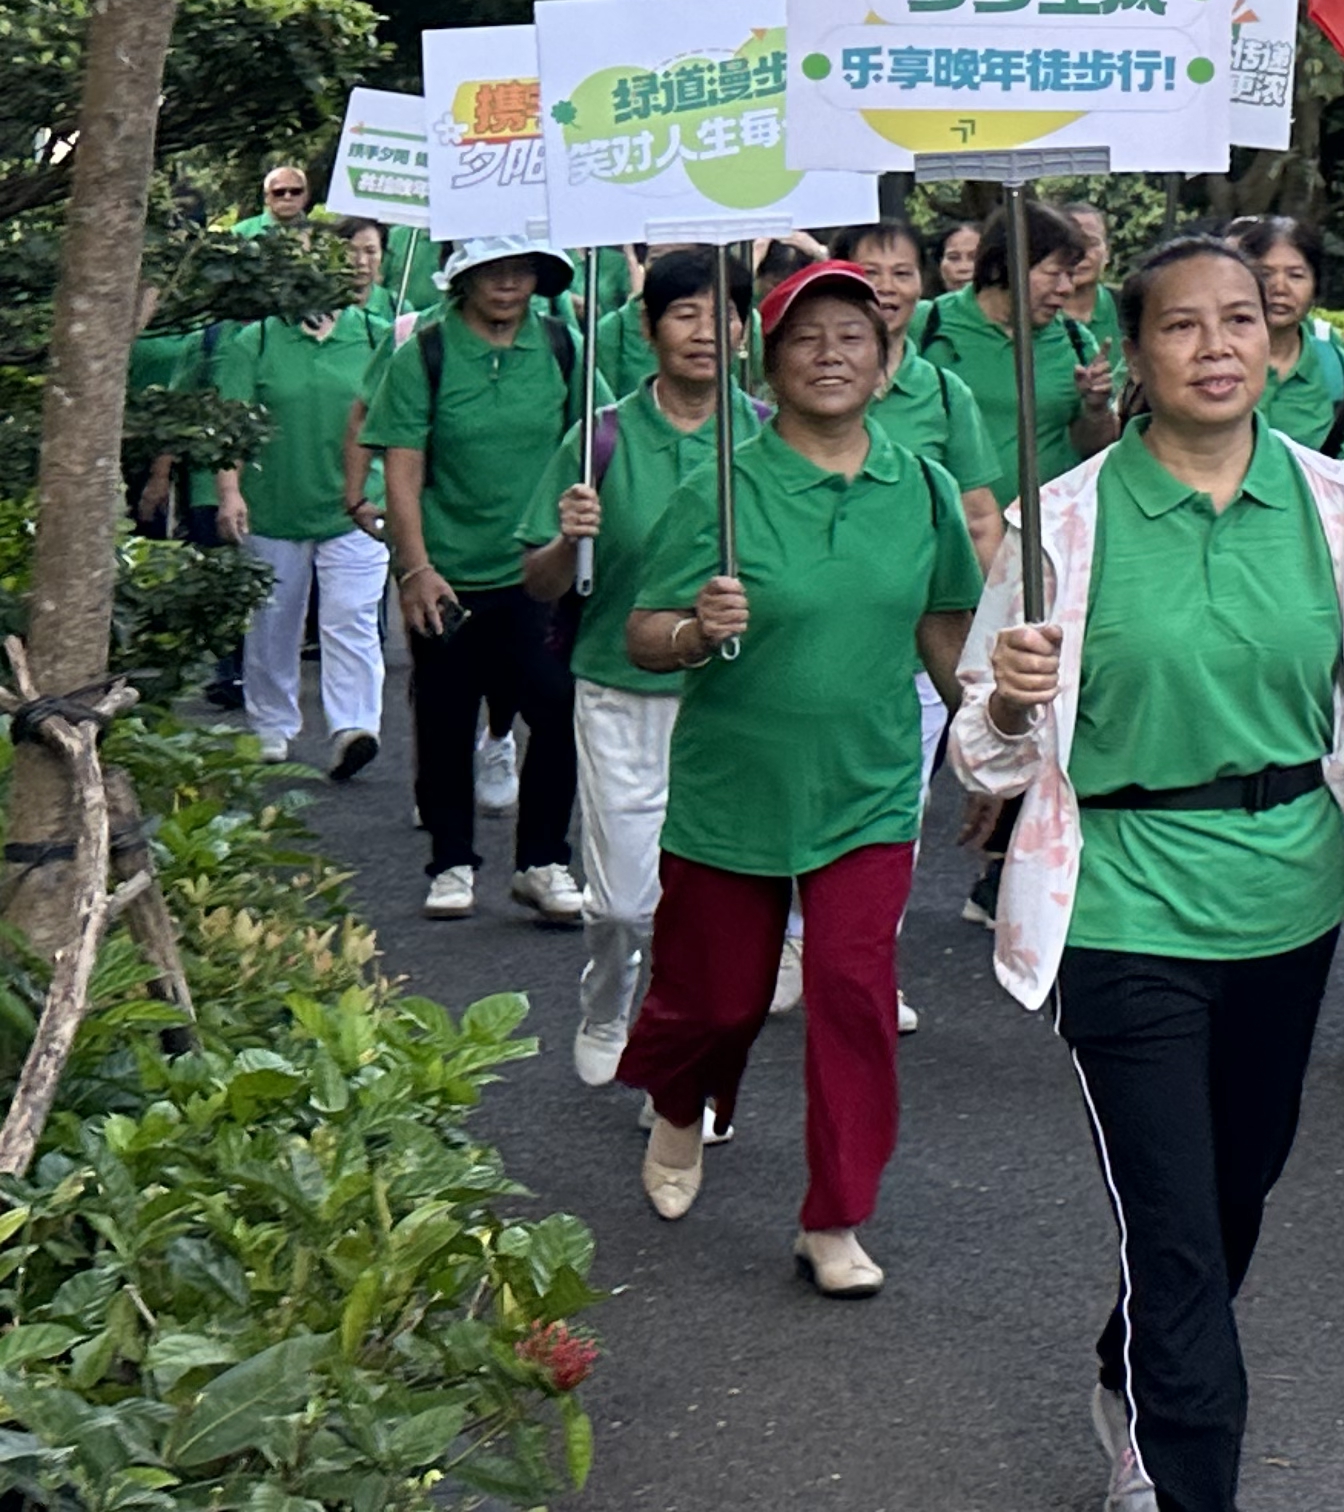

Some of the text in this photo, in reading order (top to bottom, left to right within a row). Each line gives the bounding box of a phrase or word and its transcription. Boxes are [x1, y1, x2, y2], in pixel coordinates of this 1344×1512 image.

[611, 51, 787, 123] 绿道漫步
[841, 44, 1176, 92] 乐享晚年徒步行!
[567, 107, 787, 187] 笑对人生每
